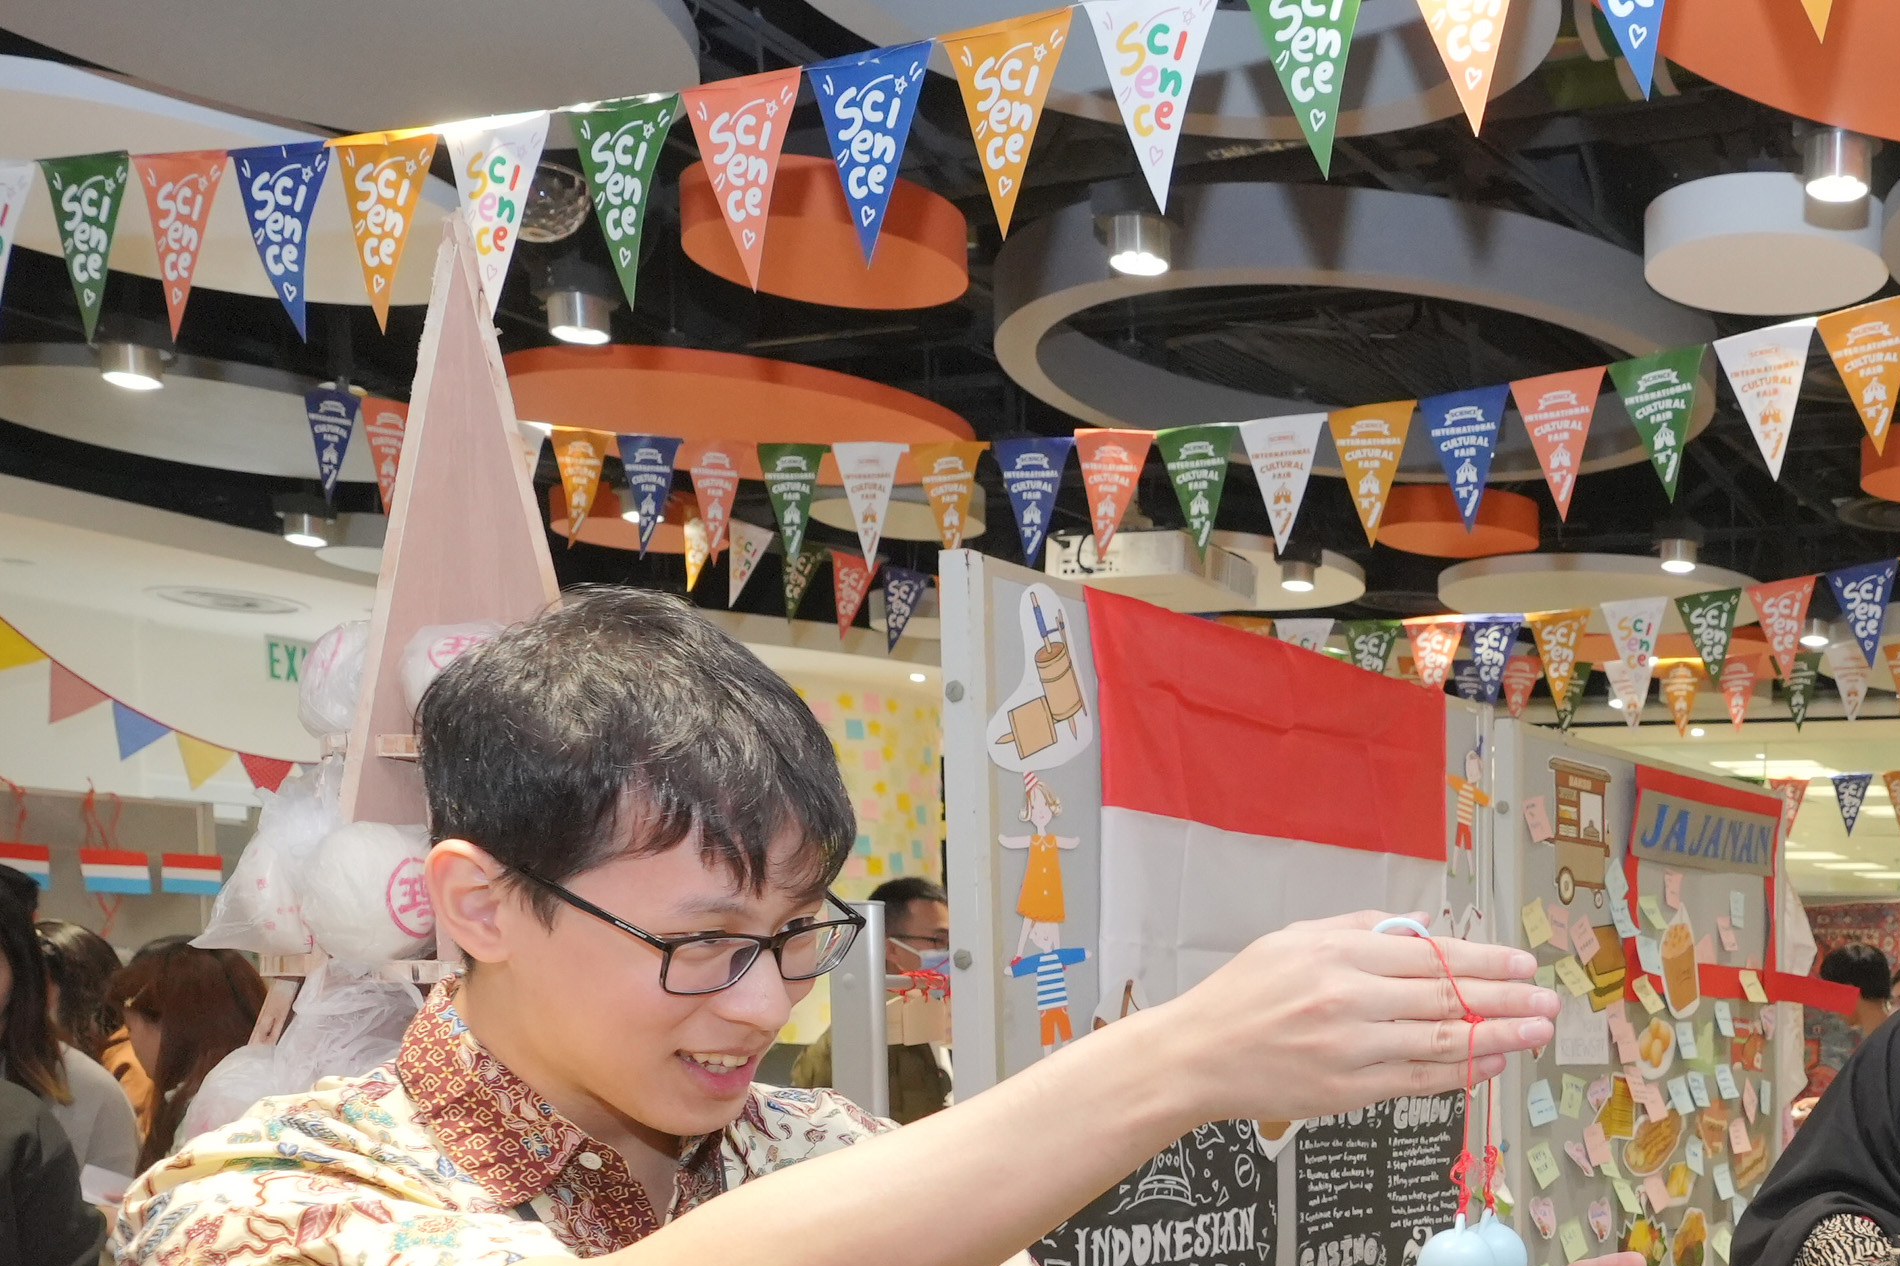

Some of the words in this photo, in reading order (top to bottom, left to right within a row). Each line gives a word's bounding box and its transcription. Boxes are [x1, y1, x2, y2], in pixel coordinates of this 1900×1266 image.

[1844, 351, 1899, 373] CULTURAL
[1859, 364, 1886, 379] FAIR
[1741, 375, 1793, 393] CULTURAL
[1756, 386, 1780, 399] FAIR
[1634, 398, 1687, 420] CULTURAL
[1650, 410, 1674, 424] FAIR
[1533, 418, 1583, 437] CULTURAL
[1440, 435, 1490, 452] CULTURAL
[1547, 429, 1570, 443] FAIR
[1454, 446, 1476, 459] FAIR
[1641, 803, 1772, 866] JAJANAN
[1330, 1168, 1341, 1179] the
